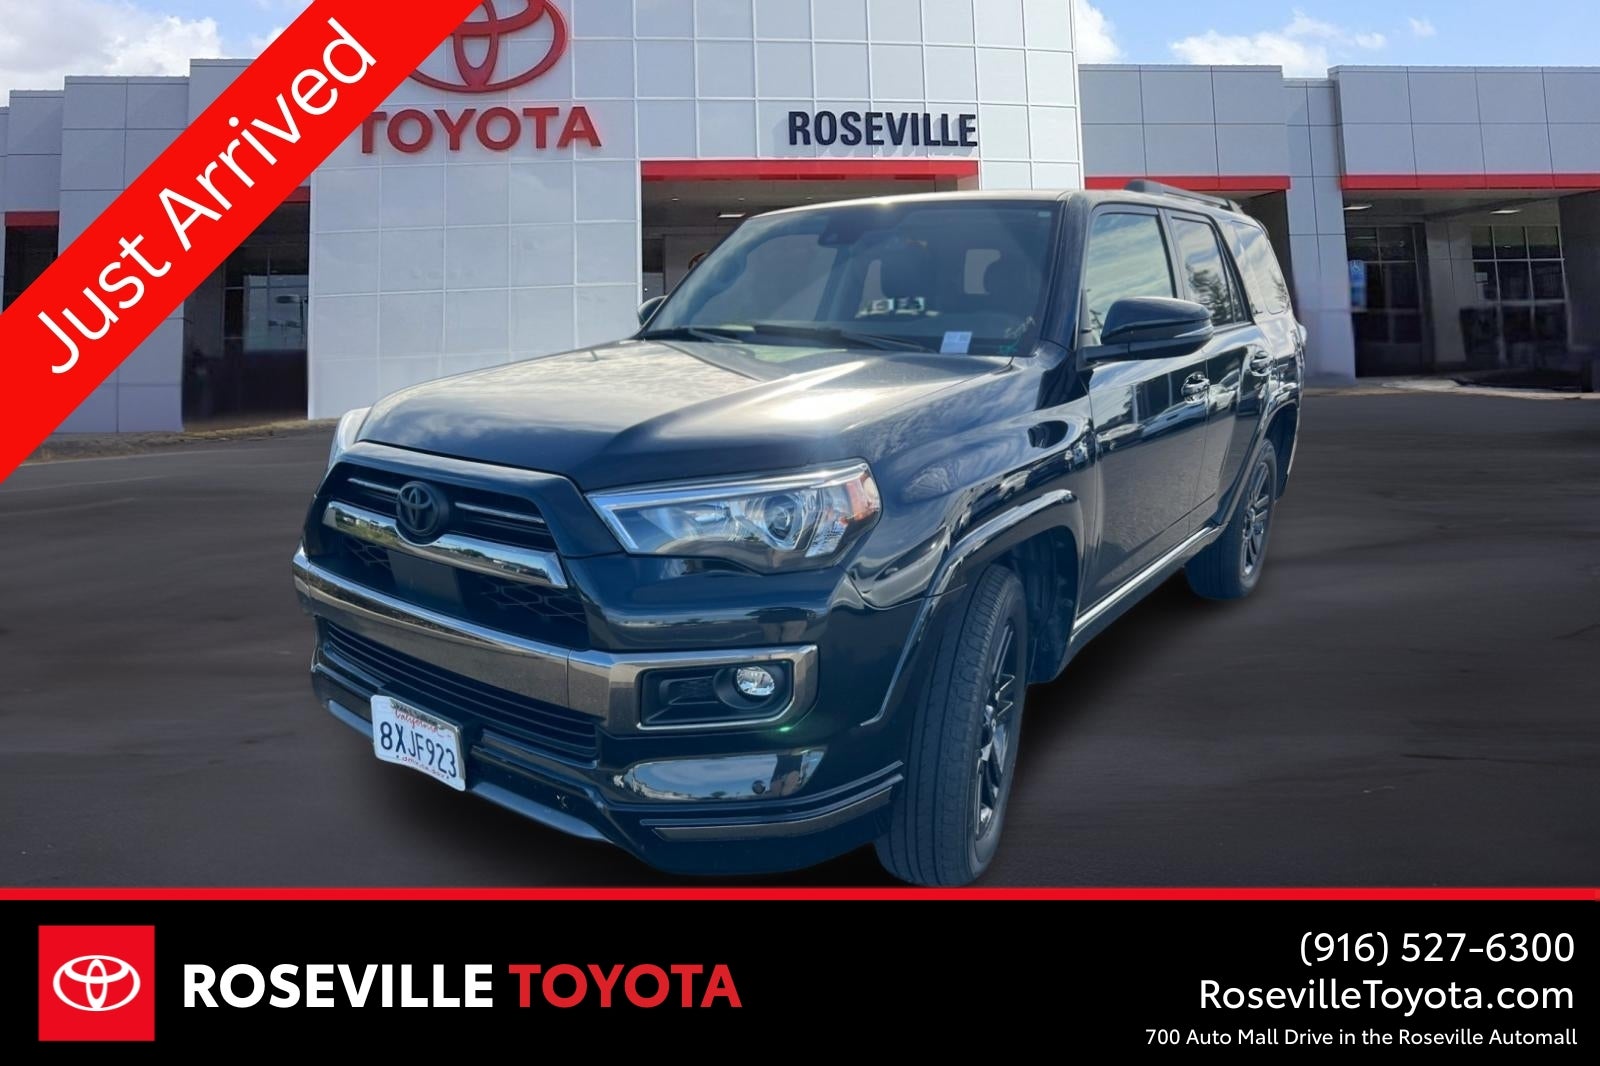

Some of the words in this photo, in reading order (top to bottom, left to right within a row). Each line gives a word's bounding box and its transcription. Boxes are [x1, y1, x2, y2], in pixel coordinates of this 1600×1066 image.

[361, 106, 602, 154] TOYOTA
[788, 111, 978, 147] ROSEVILLE
[380, 721, 457, 778] 8XJF923
